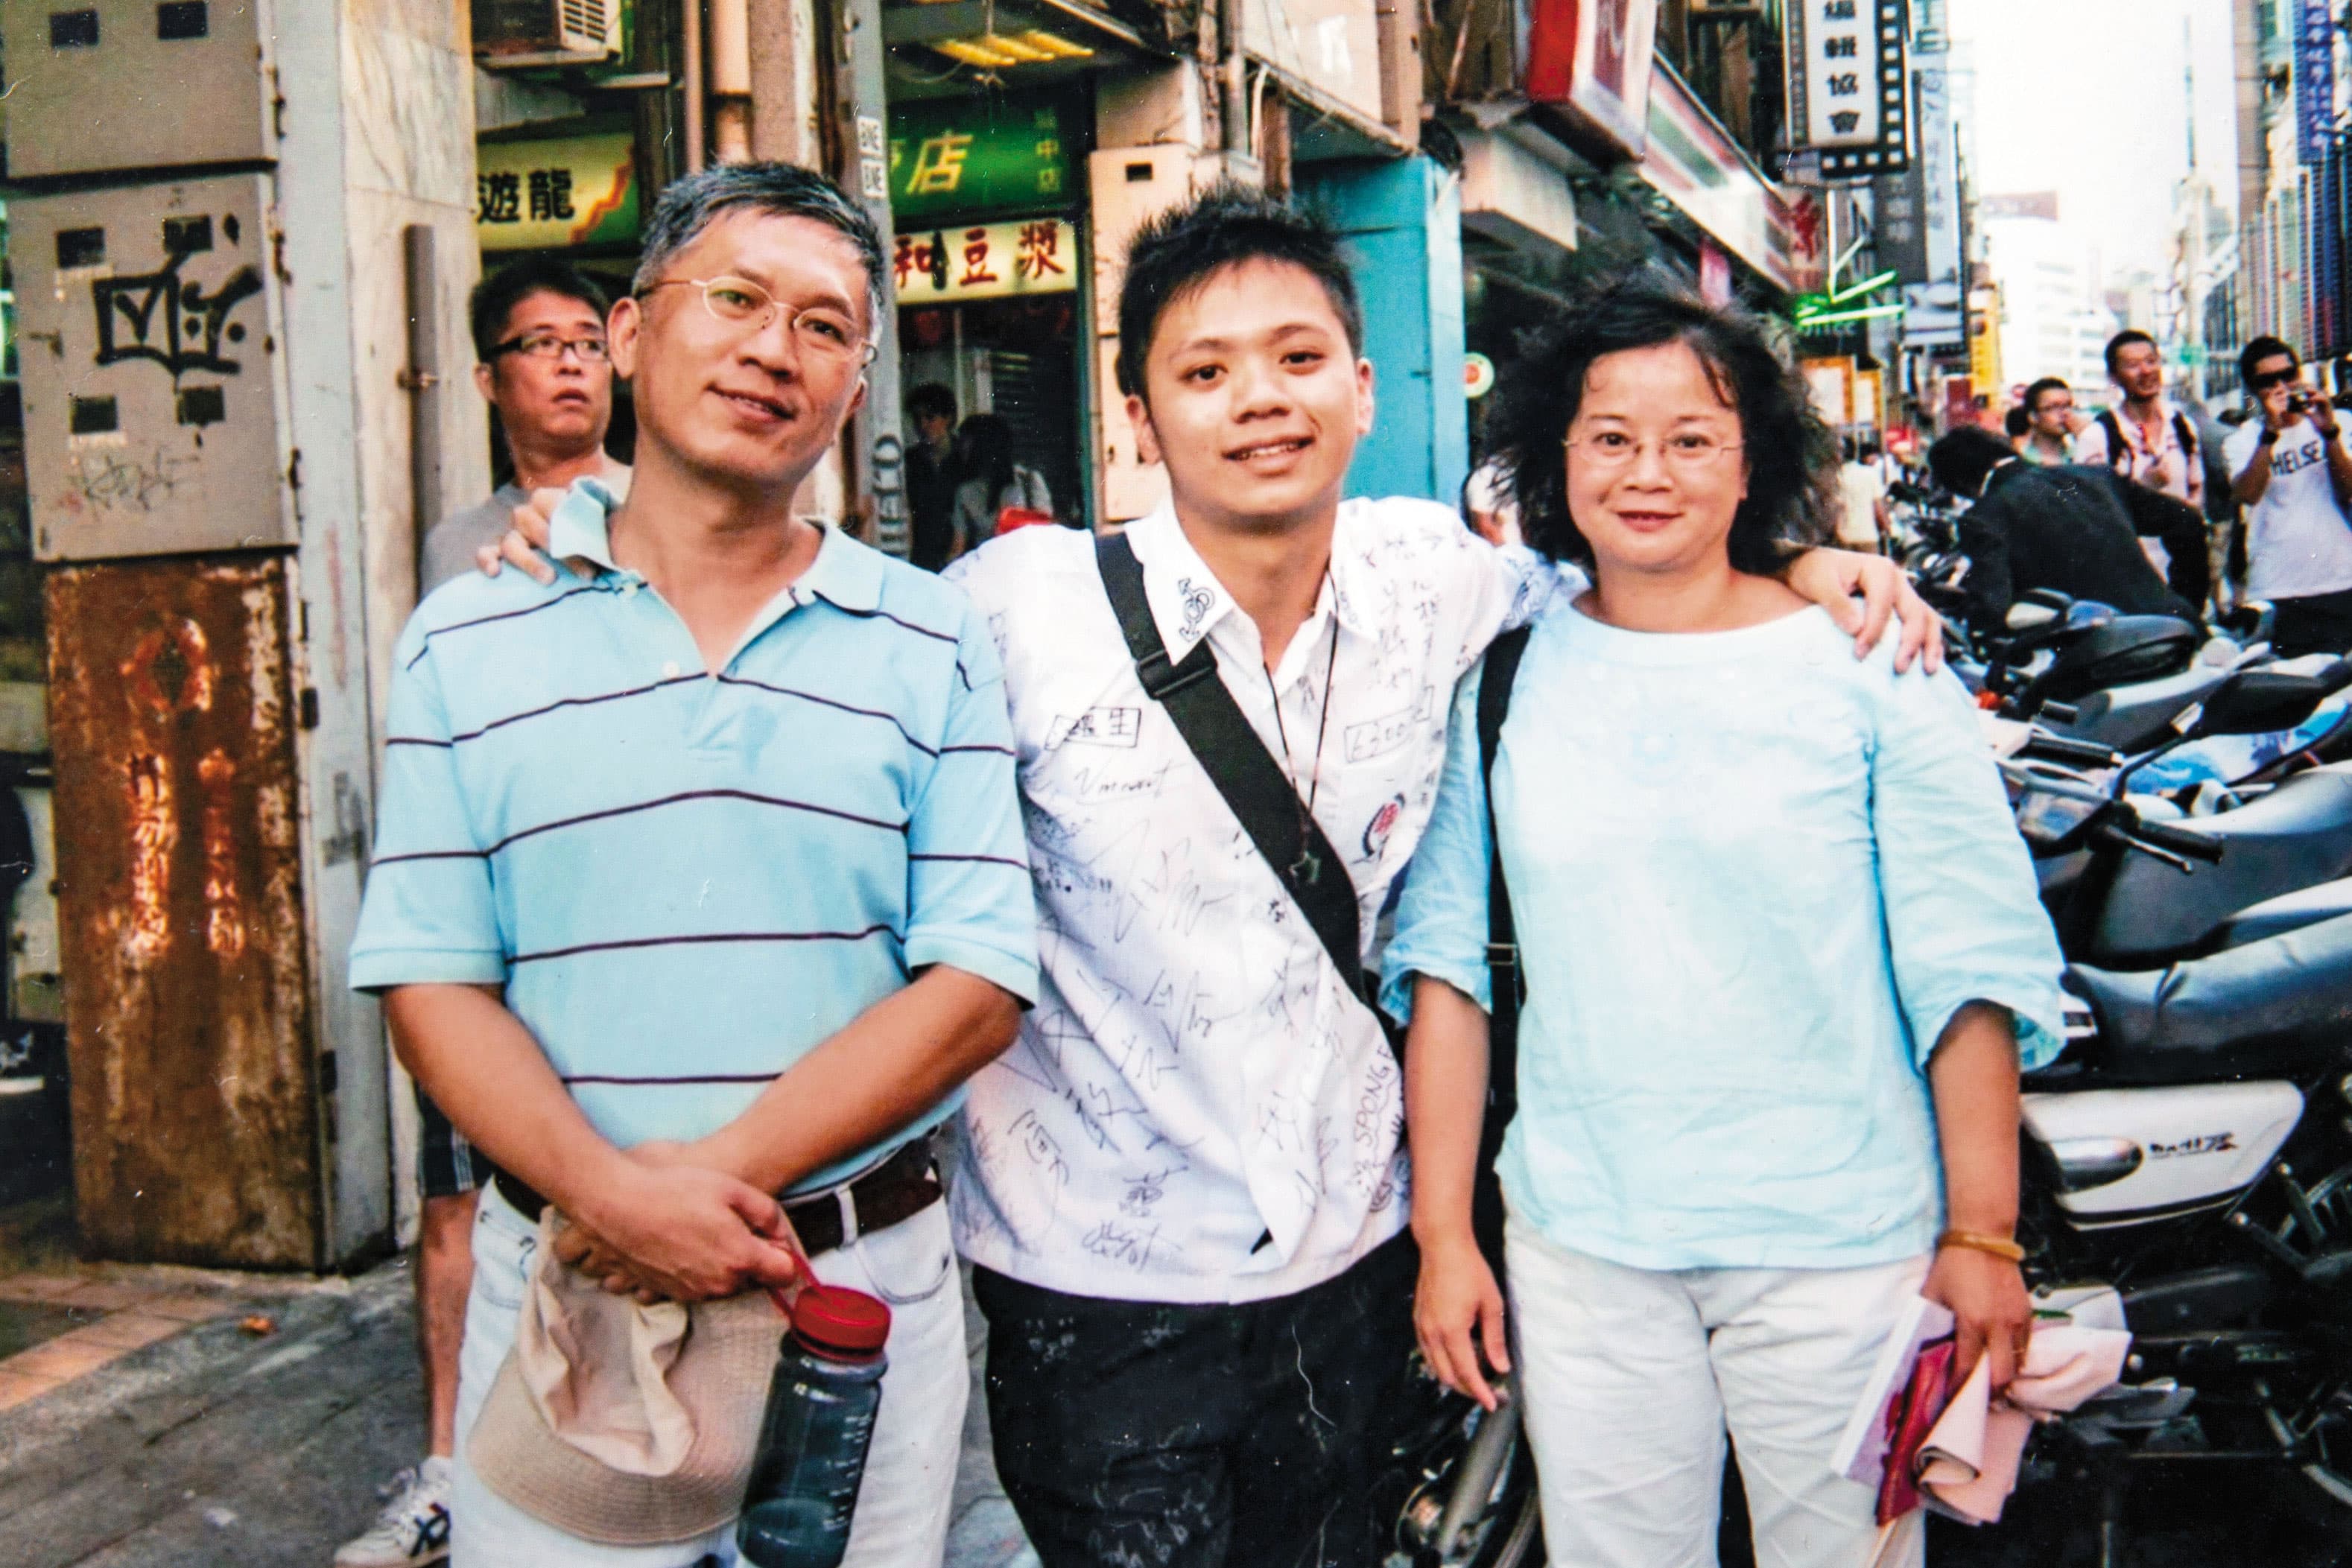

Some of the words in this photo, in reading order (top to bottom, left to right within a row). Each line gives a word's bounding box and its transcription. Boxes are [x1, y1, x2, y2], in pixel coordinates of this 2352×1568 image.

[477, 168, 575, 223] 遊龍
[895, 220, 1066, 289] 和豆漿
